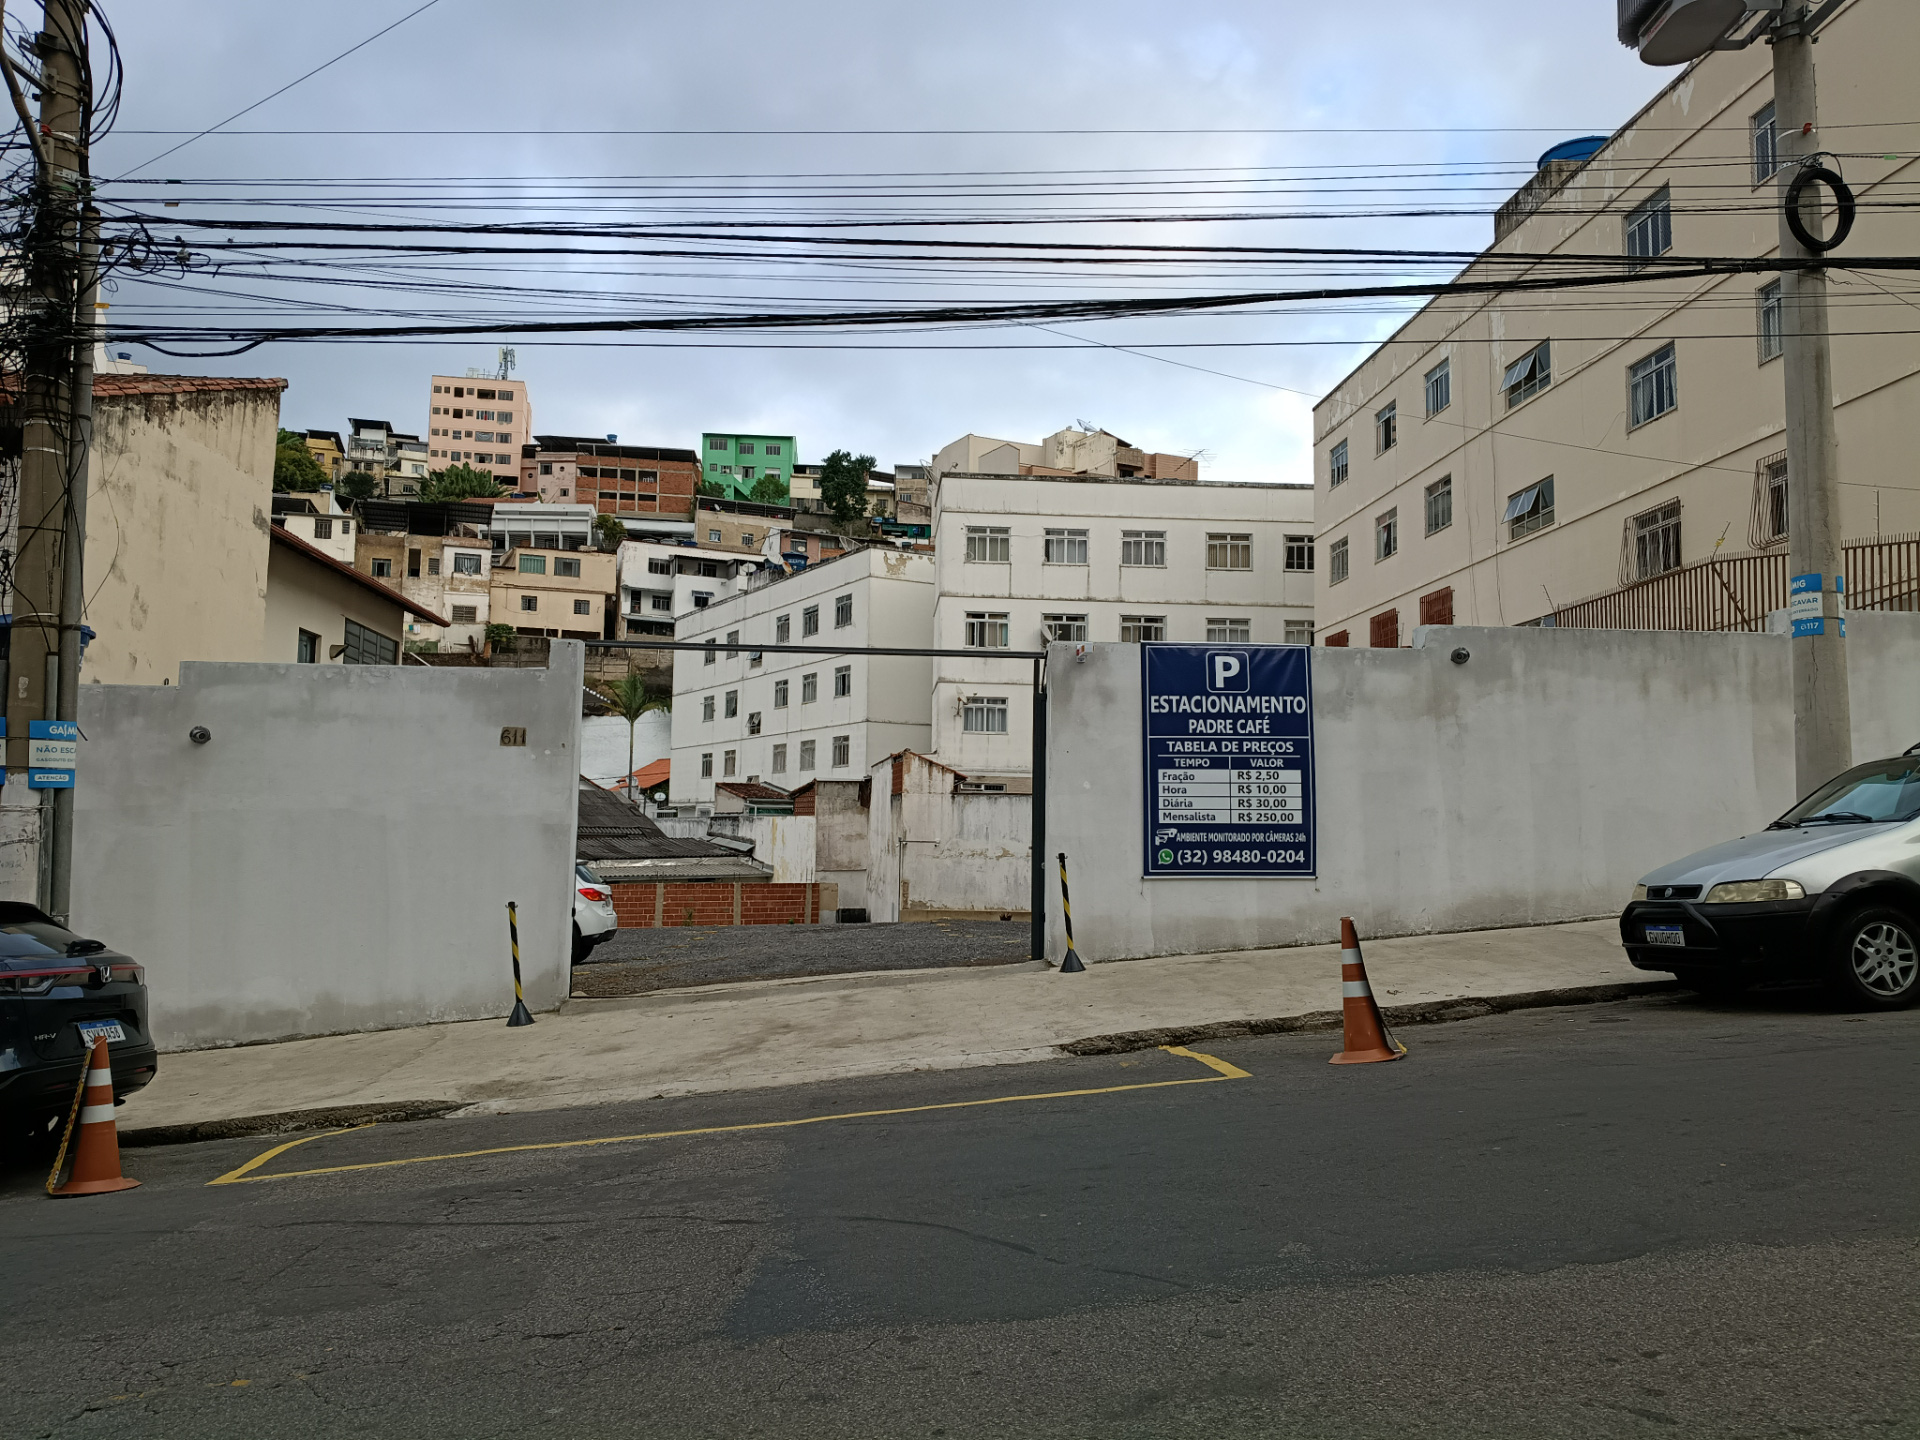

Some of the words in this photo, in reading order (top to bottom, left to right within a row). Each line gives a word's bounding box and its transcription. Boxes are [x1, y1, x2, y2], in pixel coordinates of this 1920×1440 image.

[1214, 655, 1240, 688] P
[1150, 695, 1306, 714] ESTACIONAMENTO
[1188, 719, 1233, 734] PADRE
[1236, 716, 1271, 734] CAFÉ
[501, 728, 526, 745] 611
[36, 744, 58, 753] NÃO
[1166, 741, 1218, 753] TABELA
[1221, 741, 1238, 753] DE
[1243, 741, 1294, 755] PREÇOS
[1173, 758, 1210, 767] TEMPO
[1249, 758, 1284, 768] VALOR
[1162, 771, 1195, 784] Fração
[1237, 771, 1252, 781] R$
[1255, 771, 1279, 782] 2,50
[1162, 785, 1187, 795] Hora
[1237, 784, 1252, 795] R$
[1256, 784, 1287, 795] 10,00
[1162, 798, 1193, 808] Diária
[1237, 798, 1252, 809] R$
[1256, 798, 1287, 809] 30,00
[1162, 812, 1216, 822] Mensalista
[1238, 812, 1252, 822] R$
[1256, 812, 1294, 823] 250,00
[1176, 832, 1207, 842] AMBIENTE
[1207, 832, 1251, 842] MONITORADO
[1251, 832, 1265, 842] POR
[1265, 830, 1295, 842] CÂMERAS
[1295, 832, 1307, 842] 24h
[1177, 849, 1208, 865] (32)
[1213, 849, 1305, 863] 98480-0204
[34, 1032, 57, 1041] HR-V
